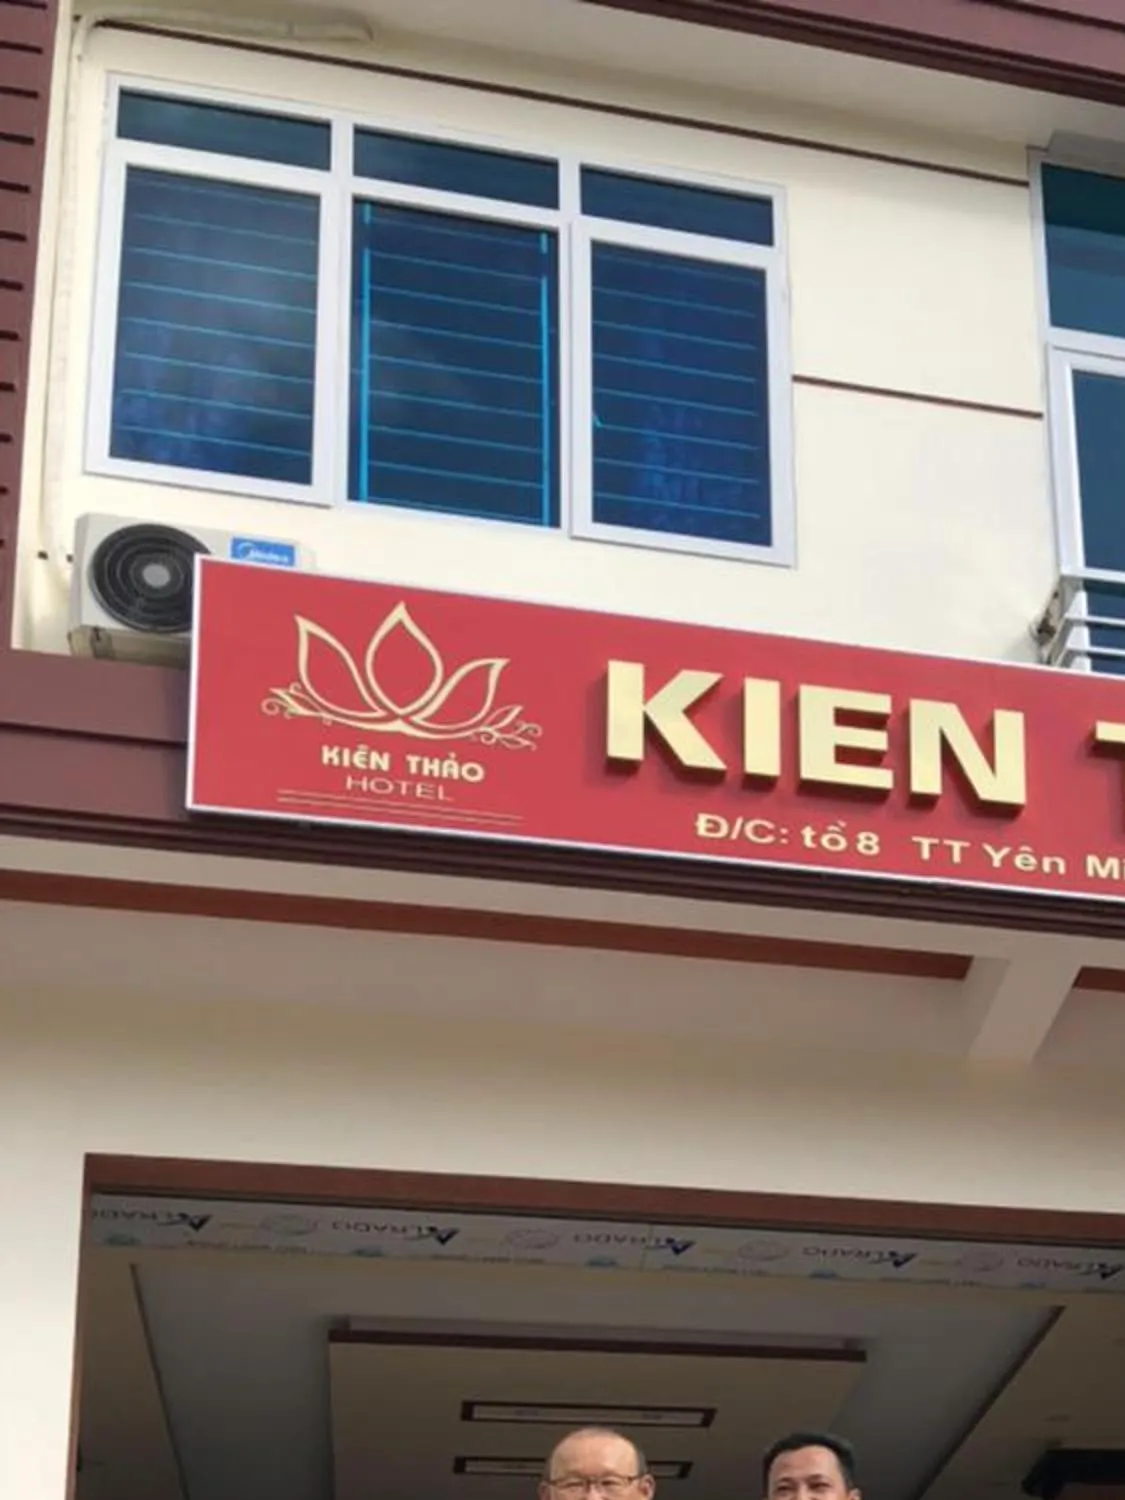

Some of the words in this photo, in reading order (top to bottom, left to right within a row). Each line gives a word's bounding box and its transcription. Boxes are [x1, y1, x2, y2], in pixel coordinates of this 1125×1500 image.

[606, 659, 1027, 808] KIEN
[406, 752, 485, 782] THẢO
[346, 775, 455, 802] HOTEL
[911, 836, 971, 864] TT
[982, 843, 1067, 876] Yên
